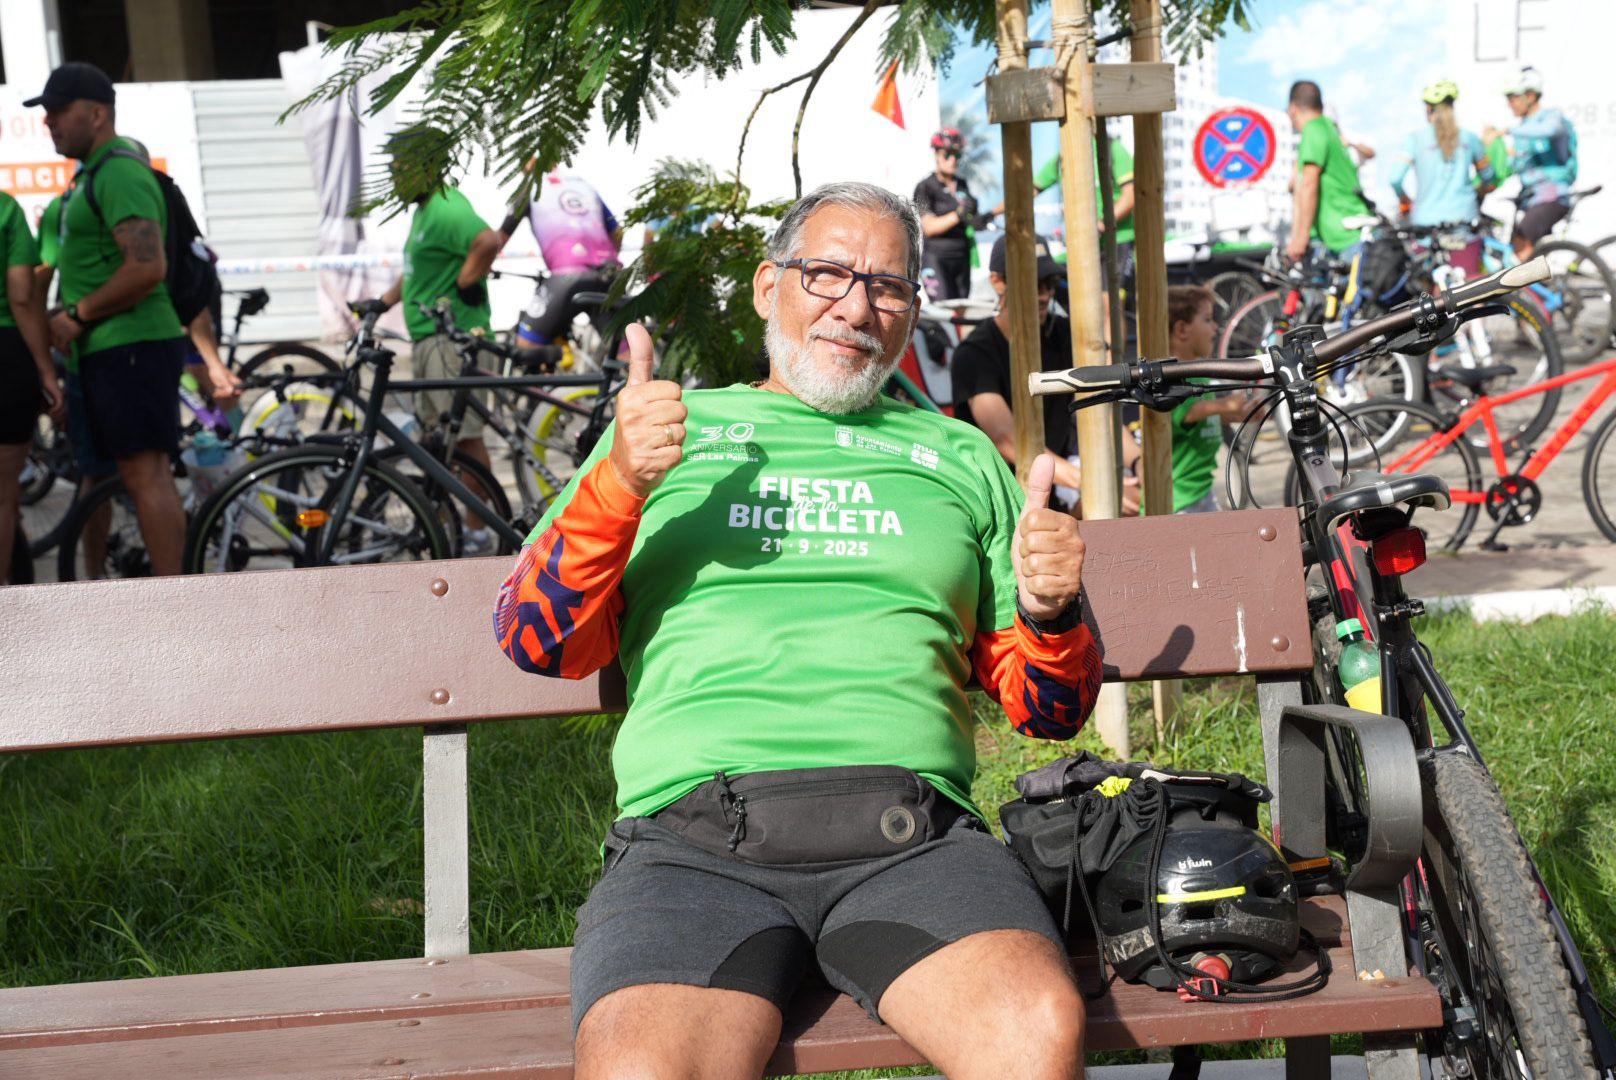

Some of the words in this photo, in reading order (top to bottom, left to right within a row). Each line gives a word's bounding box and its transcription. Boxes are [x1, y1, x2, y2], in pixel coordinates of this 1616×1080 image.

[696, 422, 755, 443] 30
[690, 443, 757, 454] ANIVERSARIO
[856, 434, 902, 453] Ayuntamiento
[687, 452, 706, 462] SER
[707, 452, 724, 461] Las
[727, 453, 759, 463] Palmas
[758, 475, 874, 504] FIESTA
[793, 496, 816, 513] de
[821, 496, 839, 513] la
[728, 503, 904, 536] BICICLETA
[760, 537, 782, 553] 21
[798, 537, 810, 554] 9
[823, 539, 869, 557] 2025
